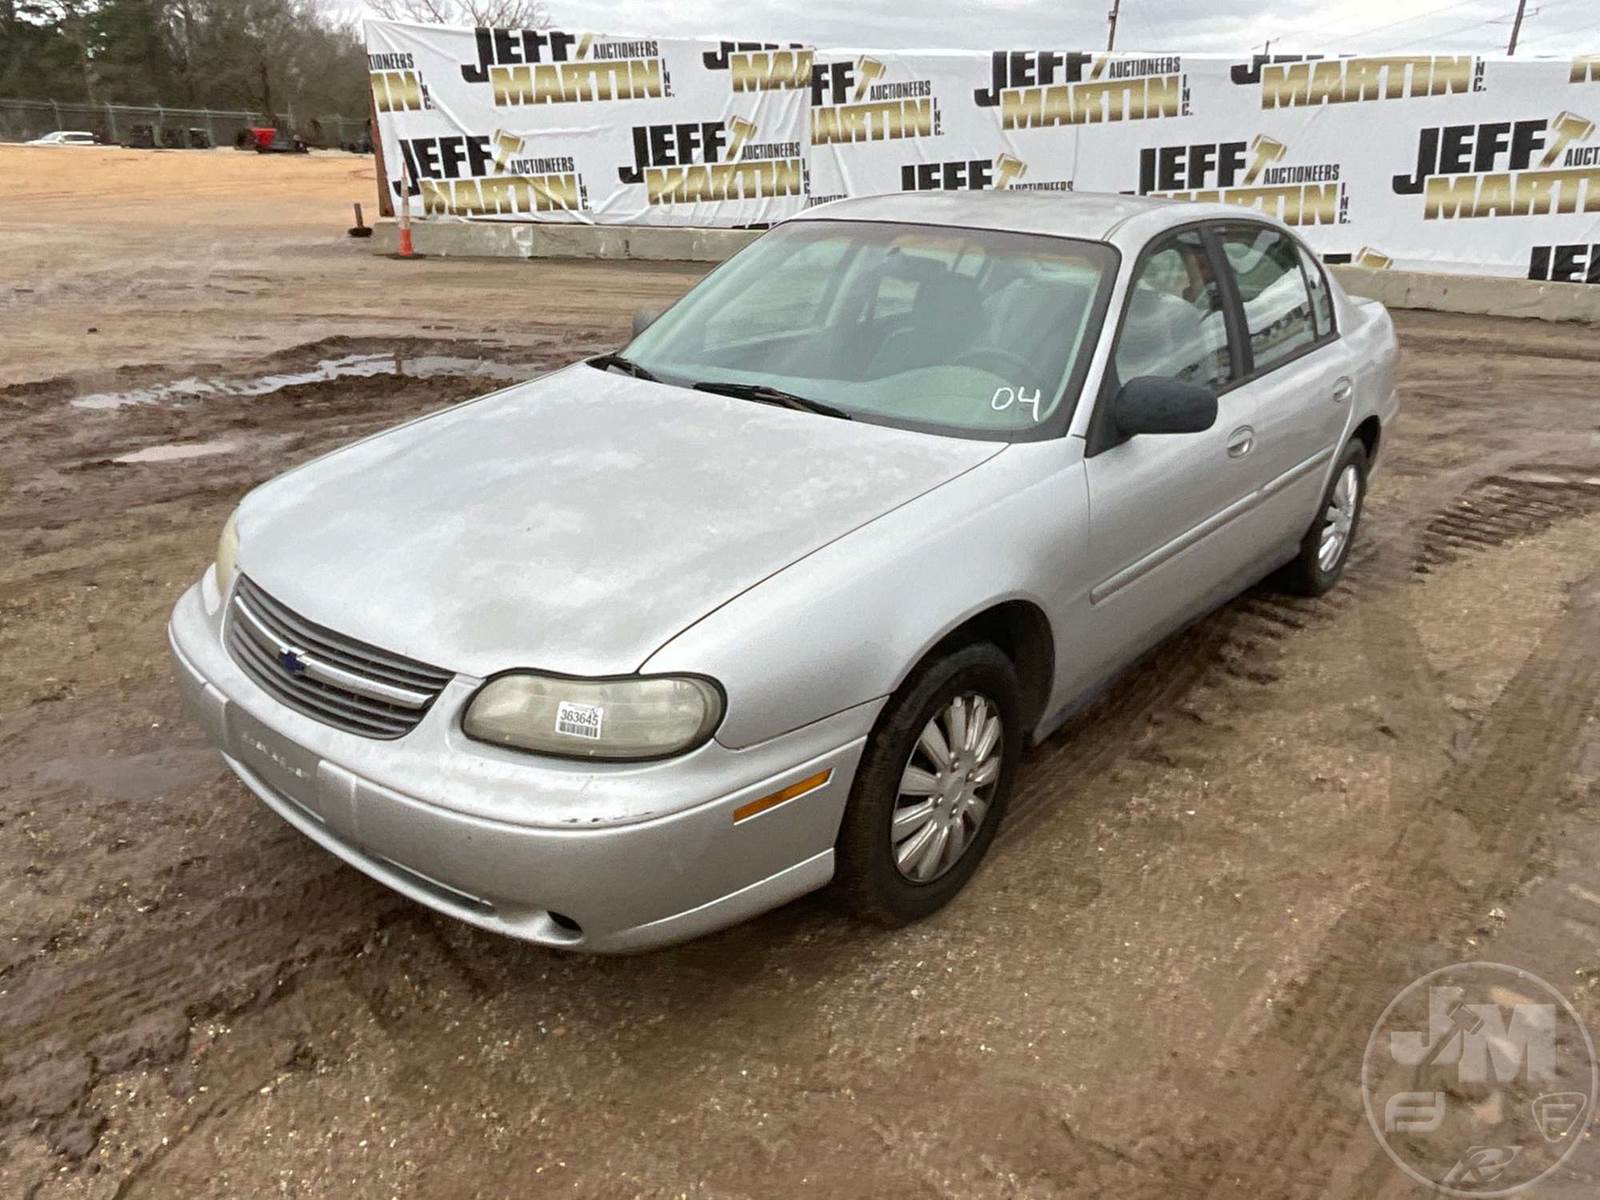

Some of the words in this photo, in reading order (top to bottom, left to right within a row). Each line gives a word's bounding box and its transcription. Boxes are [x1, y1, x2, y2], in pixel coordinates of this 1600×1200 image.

[461, 27, 575, 83] JEFF
[593, 41, 658, 60] AUCTIONEERS
[1109, 57, 1181, 79] AUCTIONEERS
[490, 59, 661, 106] MARTIN
[870, 80, 931, 100] AUCTIONEERS
[974, 51, 1092, 107] JEFF
[1262, 56, 1471, 110] MARTIN
[811, 98, 931, 145] ARTIN
[1002, 75, 1179, 130] MARTIN
[392, 136, 494, 197] JEFF
[511, 157, 574, 175] AUCTIONEERS
[618, 122, 725, 184] JEFF
[742, 143, 800, 160] AUCTIONEERS
[1263, 164, 1340, 185] AUCTIONEERS
[1392, 119, 1548, 194] JEFF
[419, 175, 579, 215] MARTIN
[646, 159, 801, 205] MARTIN
[991, 386, 1041, 422] 04
[560, 709, 599, 726] 363645
